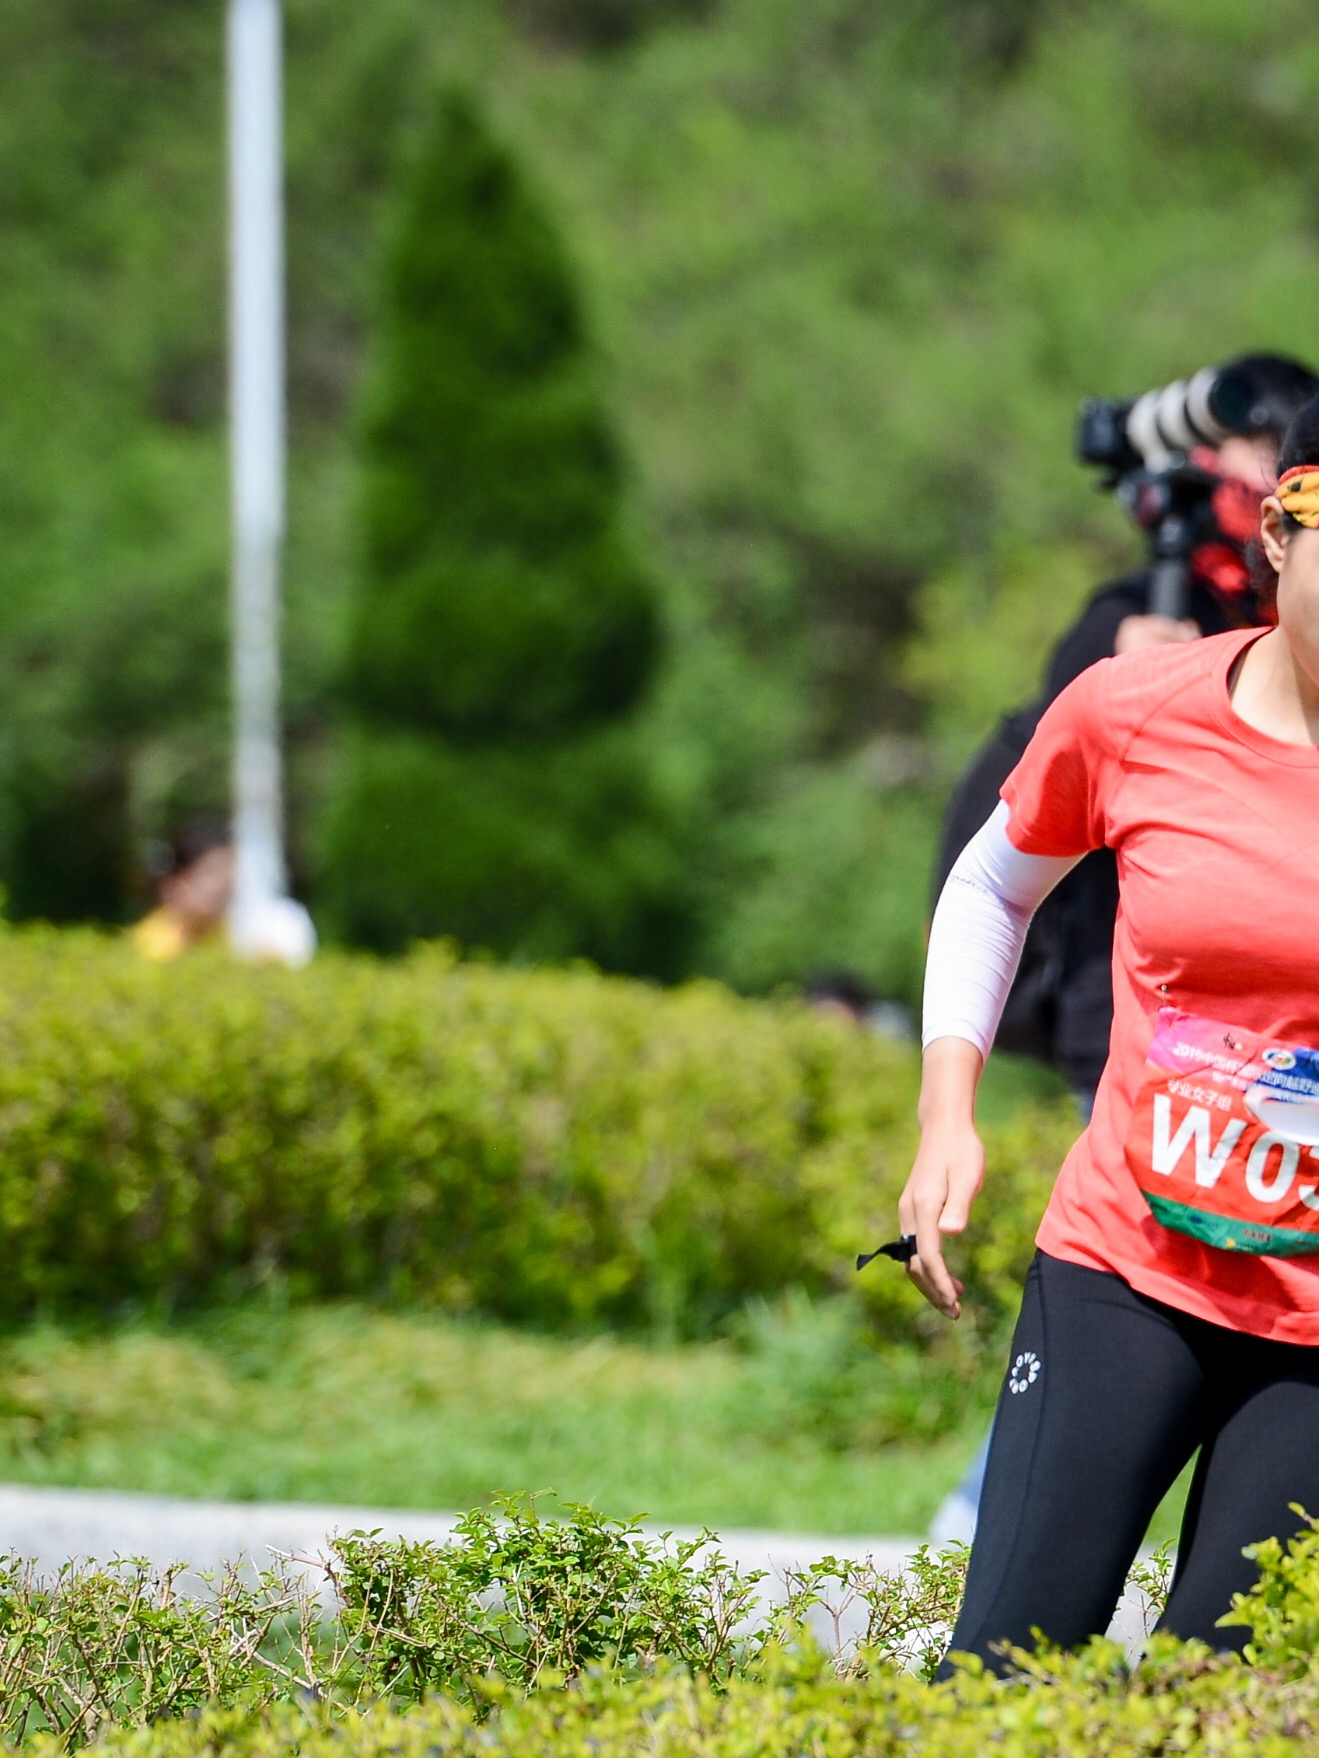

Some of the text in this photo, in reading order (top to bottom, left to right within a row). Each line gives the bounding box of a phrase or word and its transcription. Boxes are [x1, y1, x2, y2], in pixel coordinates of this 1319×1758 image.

[1168, 1079, 1232, 1112] 专业女子组
